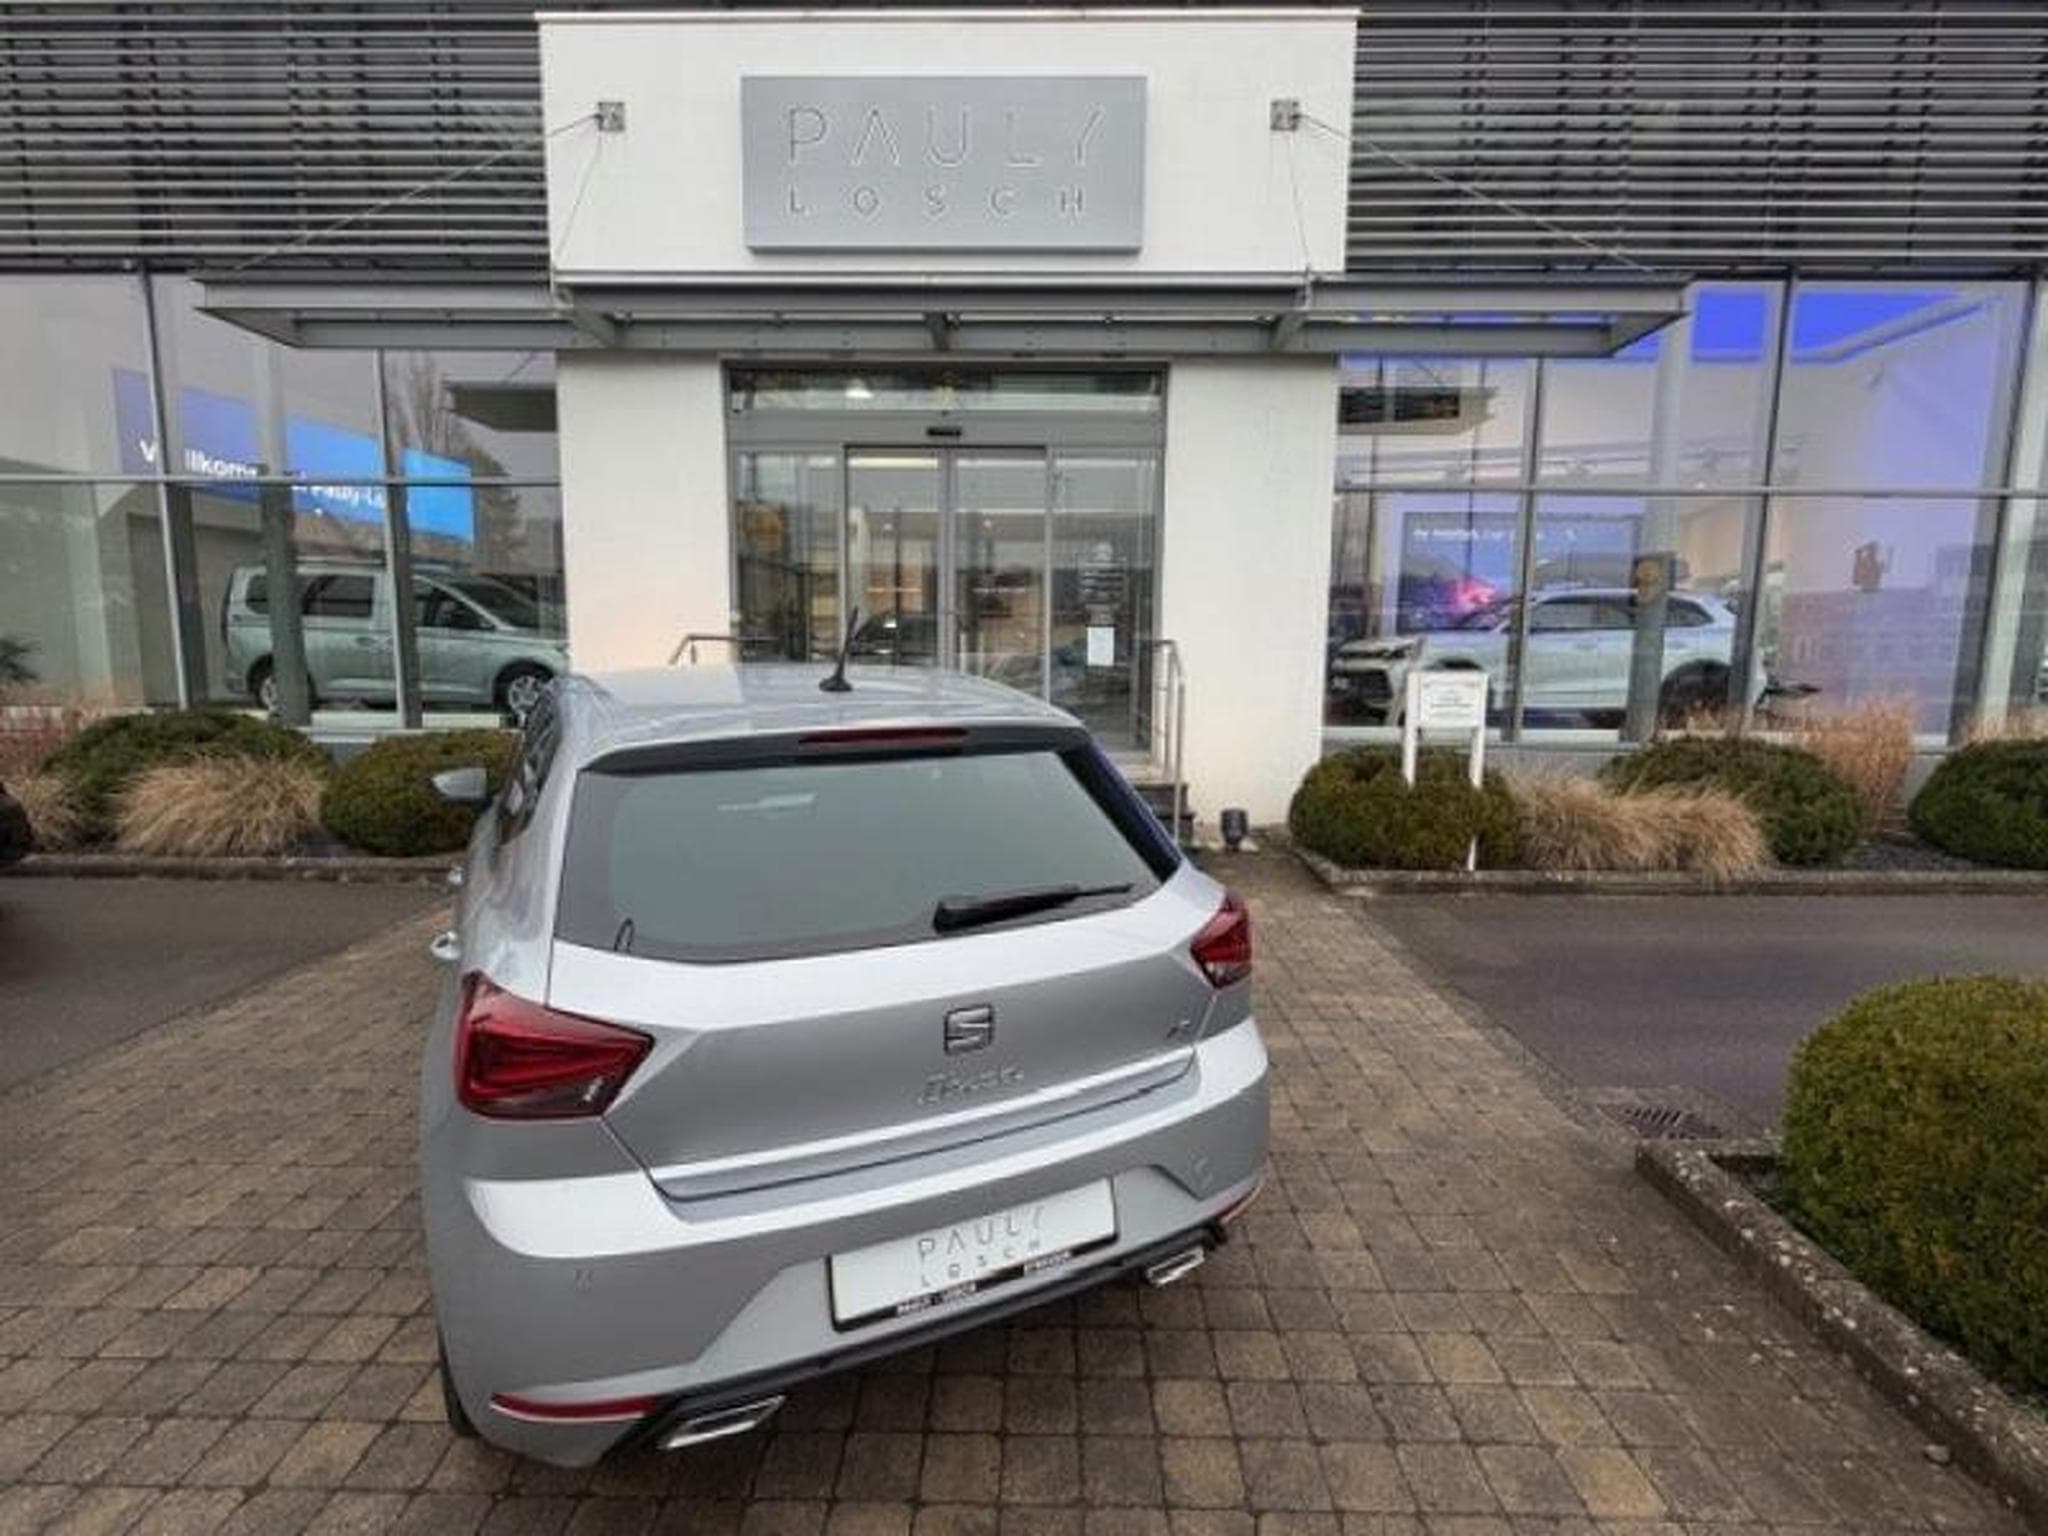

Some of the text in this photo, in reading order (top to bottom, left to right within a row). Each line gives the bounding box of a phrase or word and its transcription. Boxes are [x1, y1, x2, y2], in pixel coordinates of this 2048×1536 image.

[788, 106, 1101, 167] PAULY
[788, 184, 1084, 215] LOSCH
[917, 1204, 1045, 1262] PAULY
[920, 1239, 1041, 1288] LOSCH
